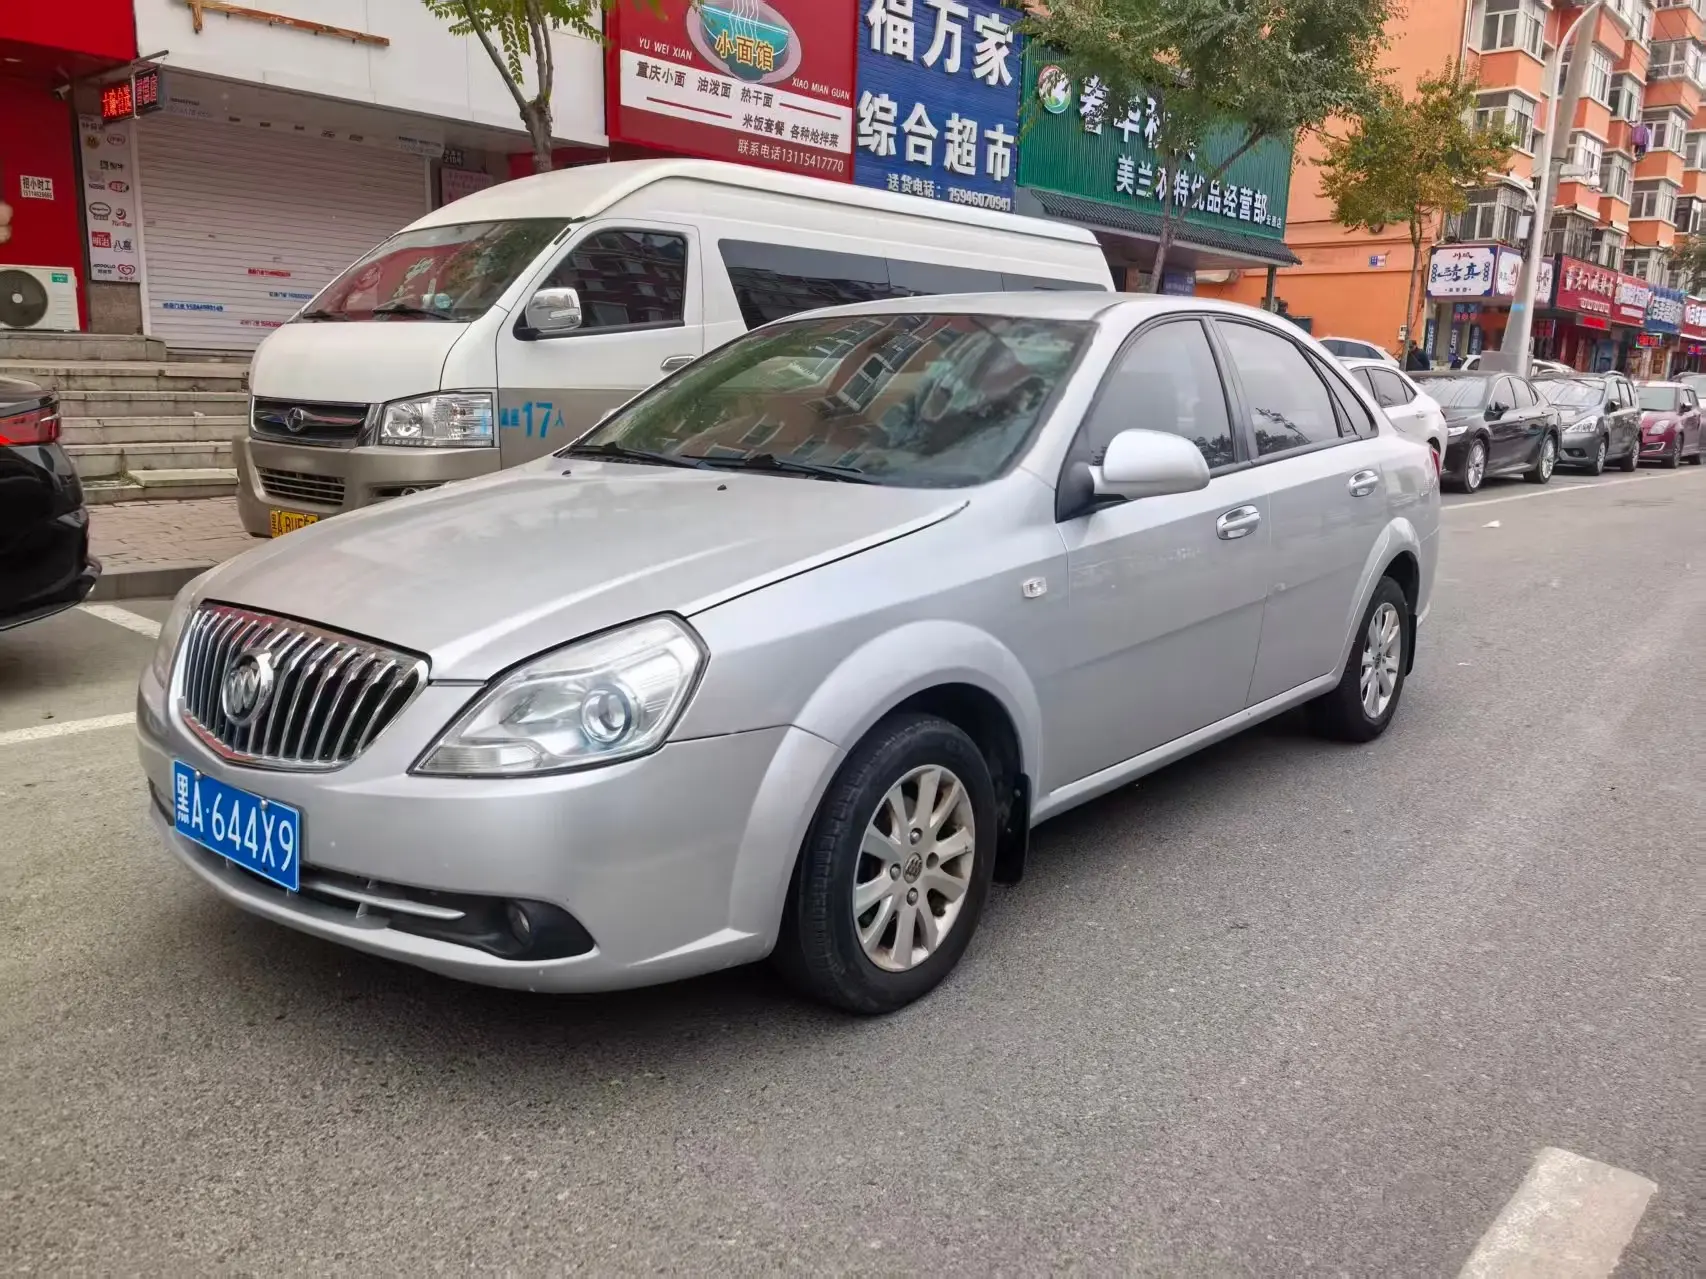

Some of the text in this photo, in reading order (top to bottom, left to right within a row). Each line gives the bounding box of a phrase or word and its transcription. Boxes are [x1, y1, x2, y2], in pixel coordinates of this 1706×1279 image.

[639, 37, 693, 60] YU WEI XIAN
[715, 31, 774, 71] 小面馆
[636, 60, 774, 108] 重庆小面 油泼面 热干面
[791, 77, 851, 101] XIAO MIAN GUAN
[742, 113, 785, 137] 米饭套餐
[857, 90, 1015, 182] 综合超市
[176, 772, 294, 872] 黑A·644X9
